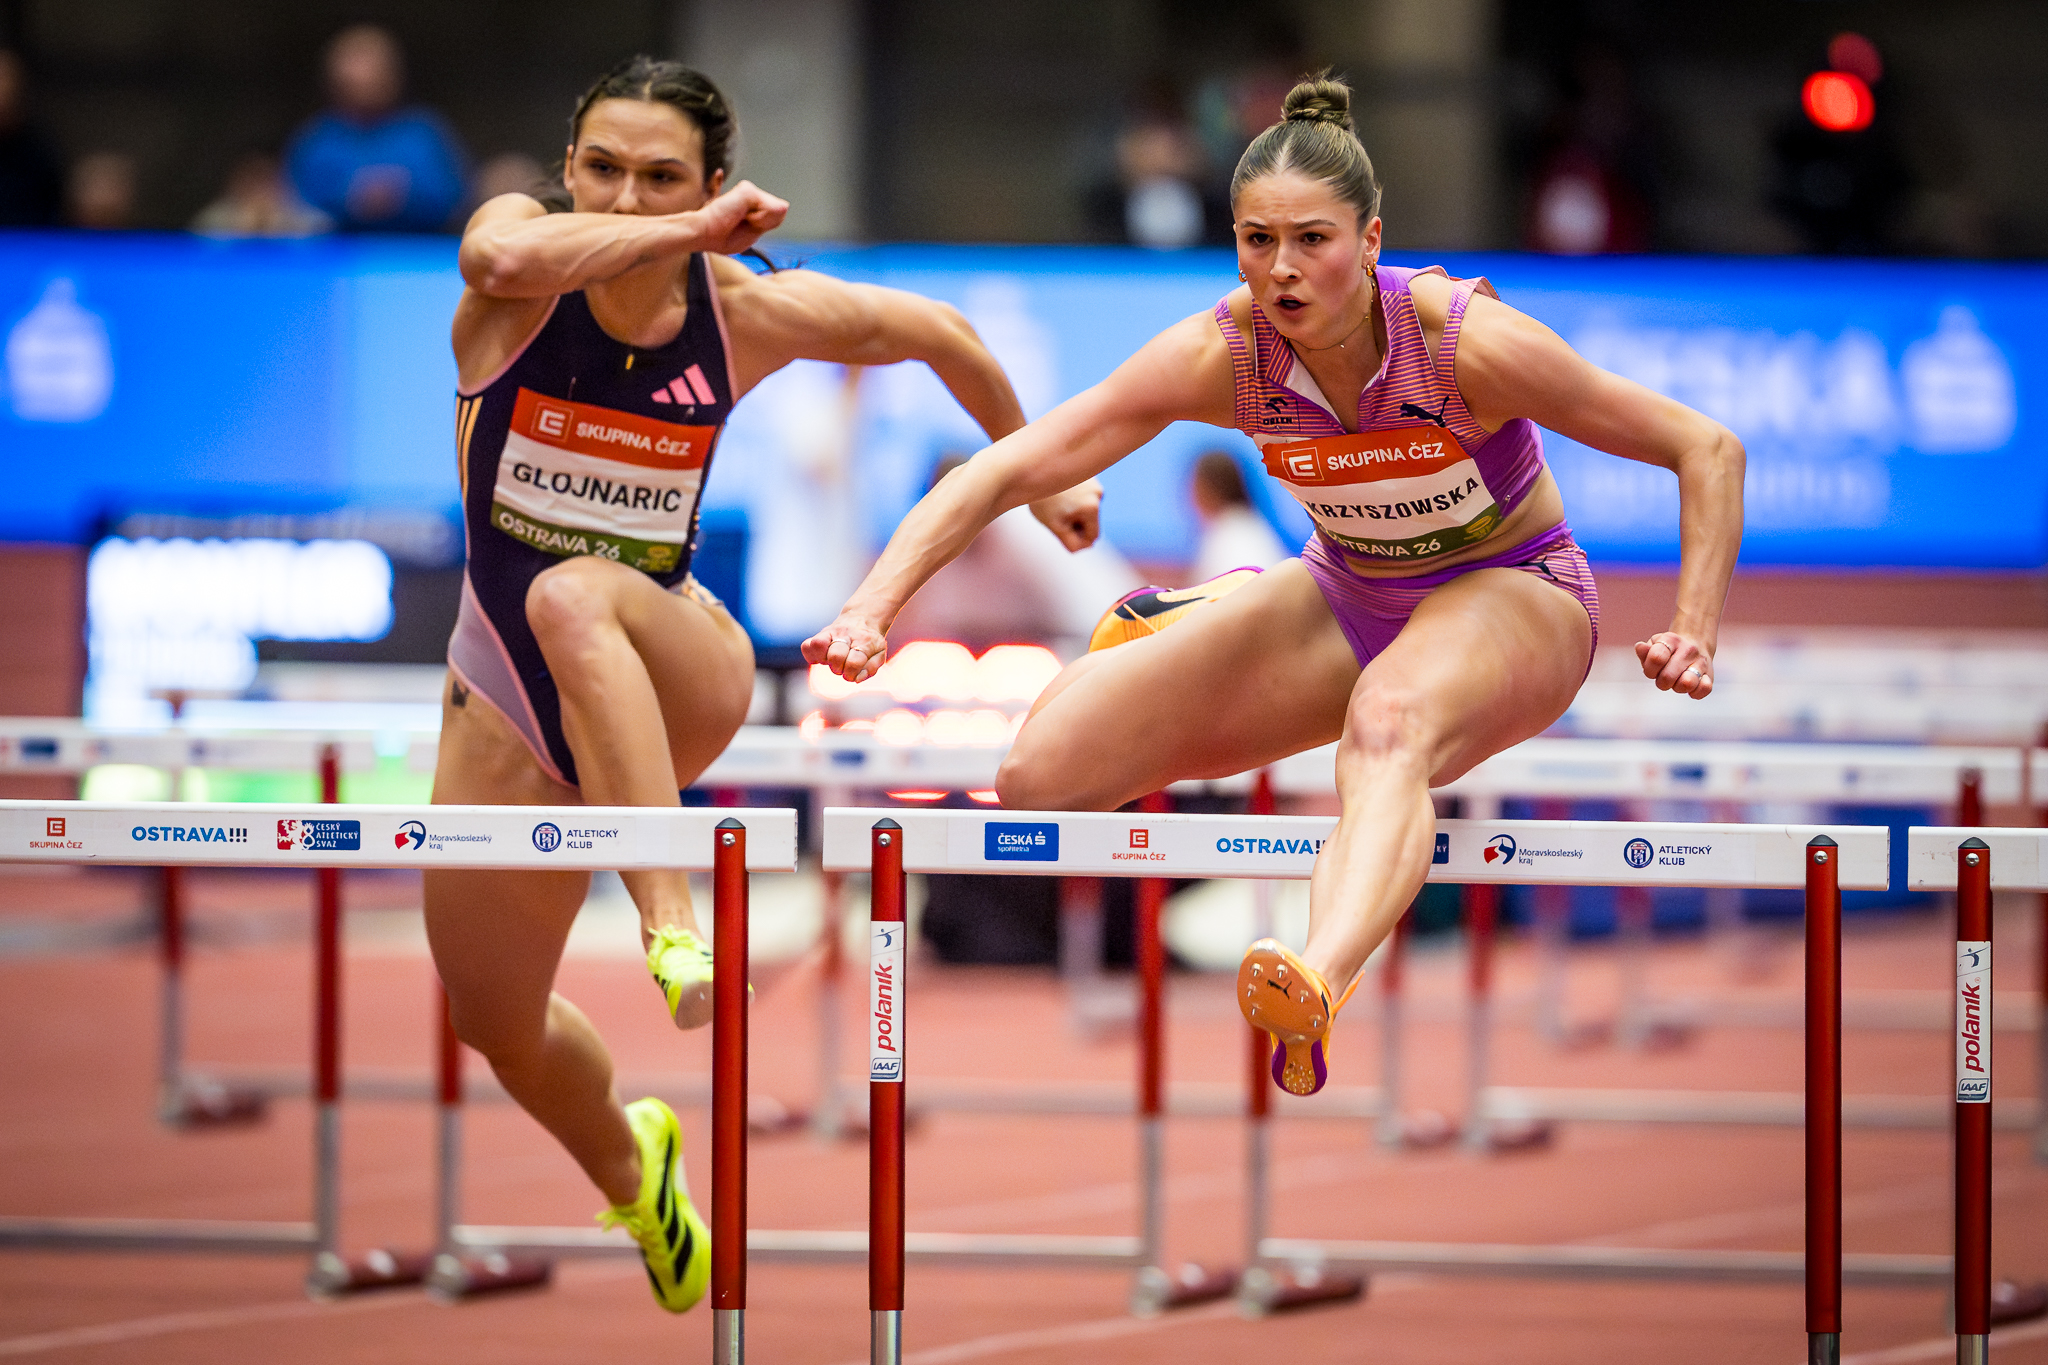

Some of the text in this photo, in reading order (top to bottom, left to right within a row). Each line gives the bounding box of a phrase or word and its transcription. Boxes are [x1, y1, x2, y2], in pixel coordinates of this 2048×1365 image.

[576, 421, 692, 457] SKUPINA ČEZ
[1326, 441, 1446, 471] SKUPINA ČEZ
[512, 462, 682, 513] GLOJNARIC
[1306, 477, 1479, 520] KRZYSZOWSKA
[498, 511, 621, 561] OSTRAVA 26
[1413, 538, 1441, 555] 26
[315, 822, 341, 831] ČESKÝ
[131, 826, 248, 843] OSTRAVA!!!
[315, 831, 359, 839] ATLETICKÝ
[566, 828, 619, 838] ATLETICKÝ
[429, 834, 492, 845] Moravskoslezský
[997, 832, 1033, 845] ČESKÁ
[29, 840, 83, 850] SKUPINA ČEZ
[316, 840, 337, 848] SVAZ
[429, 842, 443, 851] kraj
[566, 840, 593, 849] KLUB
[1518, 848, 1584, 859] Moravskoslezský
[1658, 844, 1712, 855] ATLETICKÝ
[1111, 851, 1166, 861] SKUPINA ČEZ
[1518, 856, 1533, 866] kraj
[1658, 857, 1686, 866] KLUB
[874, 963, 897, 1052] polanik
[873, 1062, 899, 1071] IAAF
[1961, 1082, 1986, 1092] IAAF
